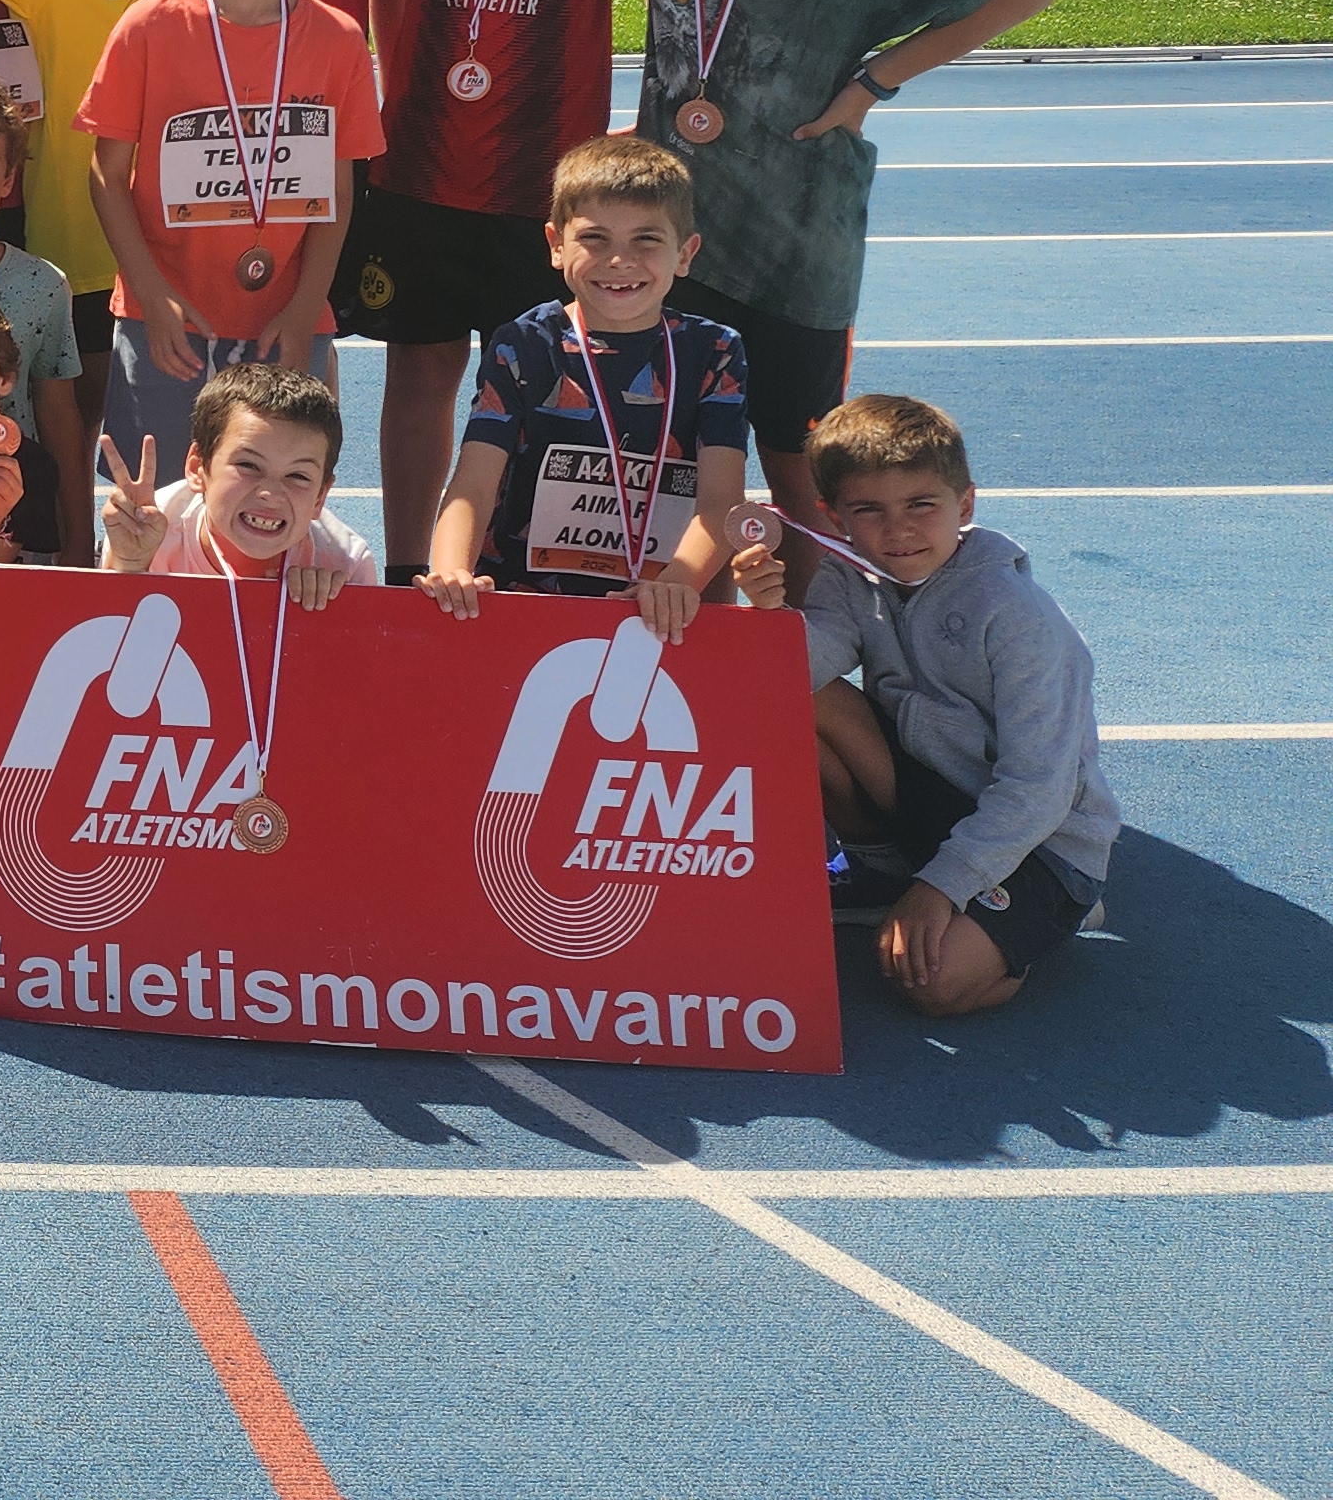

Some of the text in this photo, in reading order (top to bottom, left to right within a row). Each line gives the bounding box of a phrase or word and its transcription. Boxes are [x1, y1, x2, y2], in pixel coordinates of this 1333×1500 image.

[204, 146, 291, 166] TEMO
[84, 735, 262, 814] FNA
[575, 759, 753, 843] FNA
[562, 837, 754, 878] ATLETISMO
